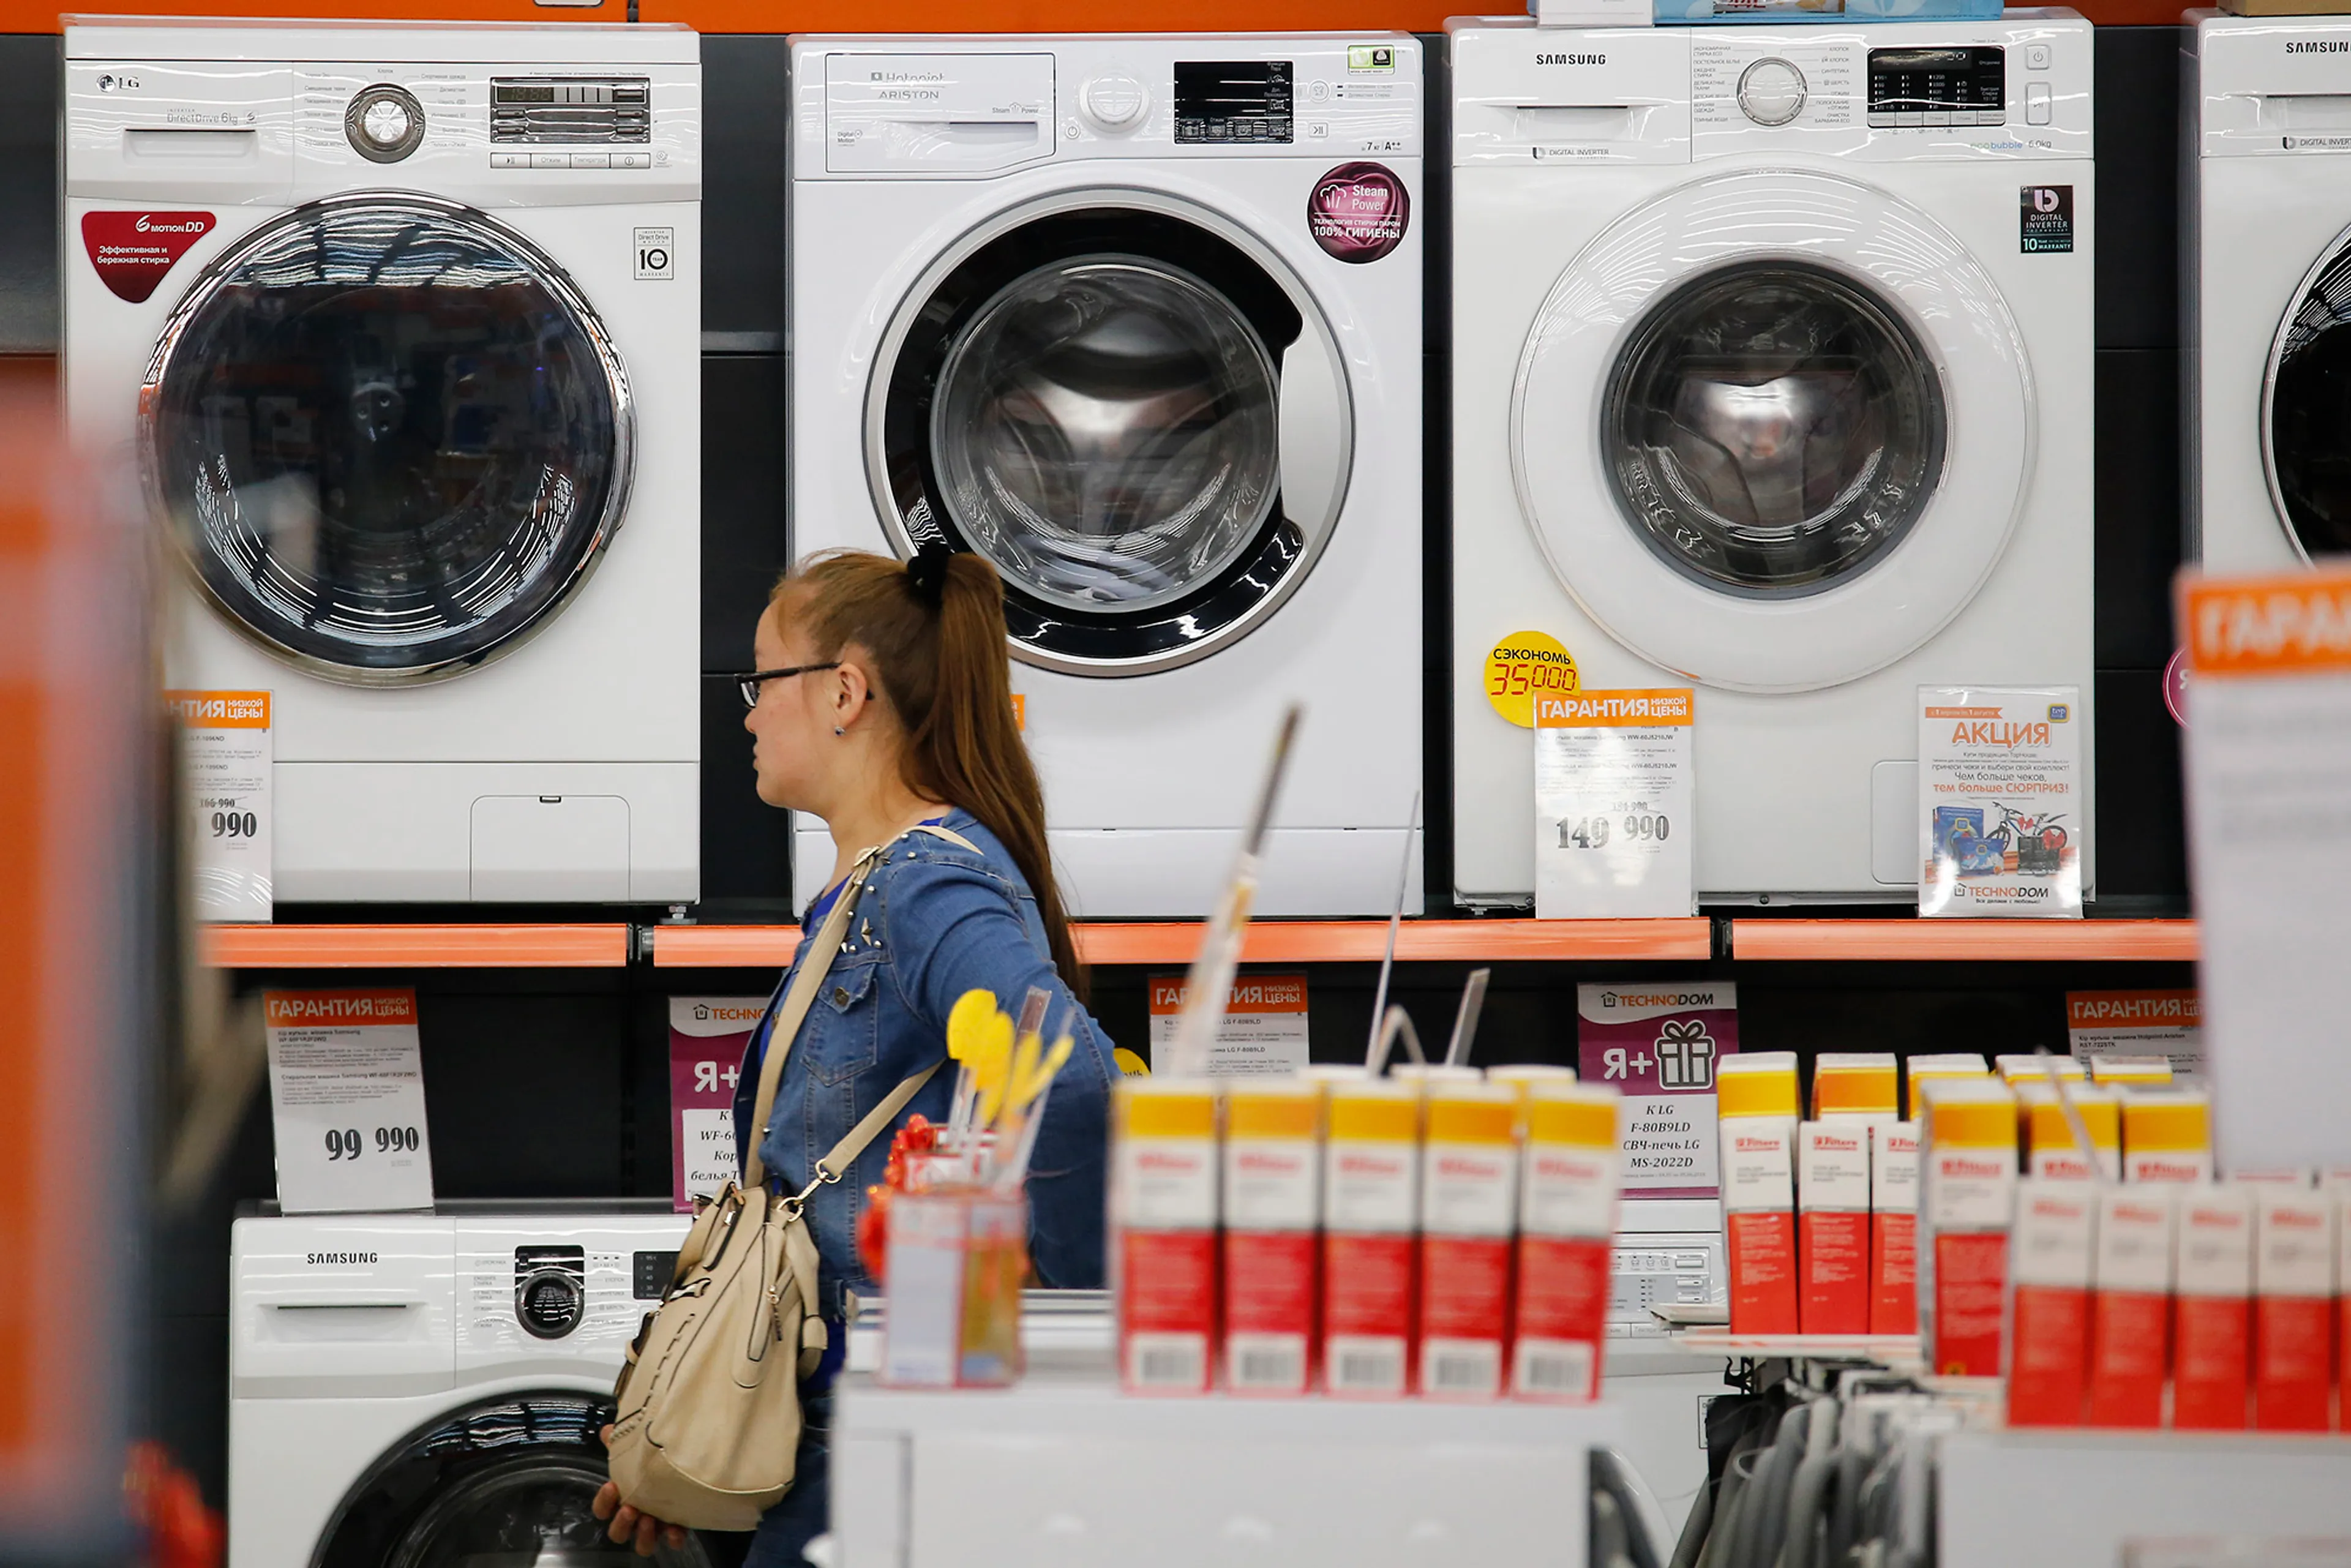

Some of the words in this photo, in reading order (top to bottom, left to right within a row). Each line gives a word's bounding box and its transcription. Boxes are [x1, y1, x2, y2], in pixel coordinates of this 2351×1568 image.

[2286, 42, 2351, 54] SAMSUN
[1536, 54, 1607, 64] SAMSUNG
[119, 77, 140, 90] LG
[879, 91, 939, 99] ARISTON
[1367, 141, 1373, 151] 7
[1352, 185, 1388, 197] Steam
[1352, 198, 1385, 211] Power
[1314, 227, 1343, 237] 100%
[1346, 227, 1400, 238] ГИГИЕНЫ
[99, 245, 160, 255] Эффективная
[2023, 238, 2038, 250] 10
[97, 255, 139, 266] бережная
[140, 257, 170, 265] стирка
[639, 249, 669, 270] 10
[1493, 648, 1571, 665] СЭКОНОМЬ
[228, 698, 263, 708] НИЗКОЙ
[1651, 696, 1687, 706] НИЗКОЙ
[228, 708, 263, 720] ЦЕНЫ
[1540, 698, 1649, 719] ГАРАНТИЯ
[1651, 706, 1687, 718] ЦЕНЫ
[1952, 721, 2050, 749] АКЦИЯ
[1955, 772, 1974, 781] Чем
[1977, 772, 2014, 781] больше
[2017, 773, 2047, 782] чеков,
[1933, 784, 1955, 792] тем
[1959, 782, 2003, 792] больше
[2006, 782, 2069, 793] СЮРПРИЗ!
[218, 798, 235, 808] 990
[211, 812, 257, 838] 990
[1556, 816, 1610, 849] 149
[1624, 815, 1670, 841] 990
[1968, 887, 2049, 898] TECHNODOM
[1264, 983, 1300, 992] НИЗКОЙ
[375, 996, 409, 1005] НИЗКОЙ
[1156, 986, 1262, 1005] ГАРТИЯ
[1264, 993, 1301, 1005] ЦЕНЫ
[1619, 993, 1714, 1007] TECHNODOM
[269, 997, 373, 1018] ГАРАНТИЯ
[375, 1005, 409, 1018] ЦЕНЫ
[2073, 999, 2181, 1019] ГАРАНТИЯ
[711, 1008, 765, 1020] TECHN
[1658, 1105, 1674, 1116] LG
[1630, 1122, 1692, 1133] F-80B9LD
[324, 1129, 363, 1161] 99
[375, 1127, 419, 1153] 990
[1623, 1139, 1682, 1151] СВЧ-печь
[1684, 1139, 1700, 1150] LG
[714, 1150, 737, 1163] Кор
[1630, 1157, 1694, 1168] MS-2022D
[307, 1251, 378, 1265] SAMSUNG
